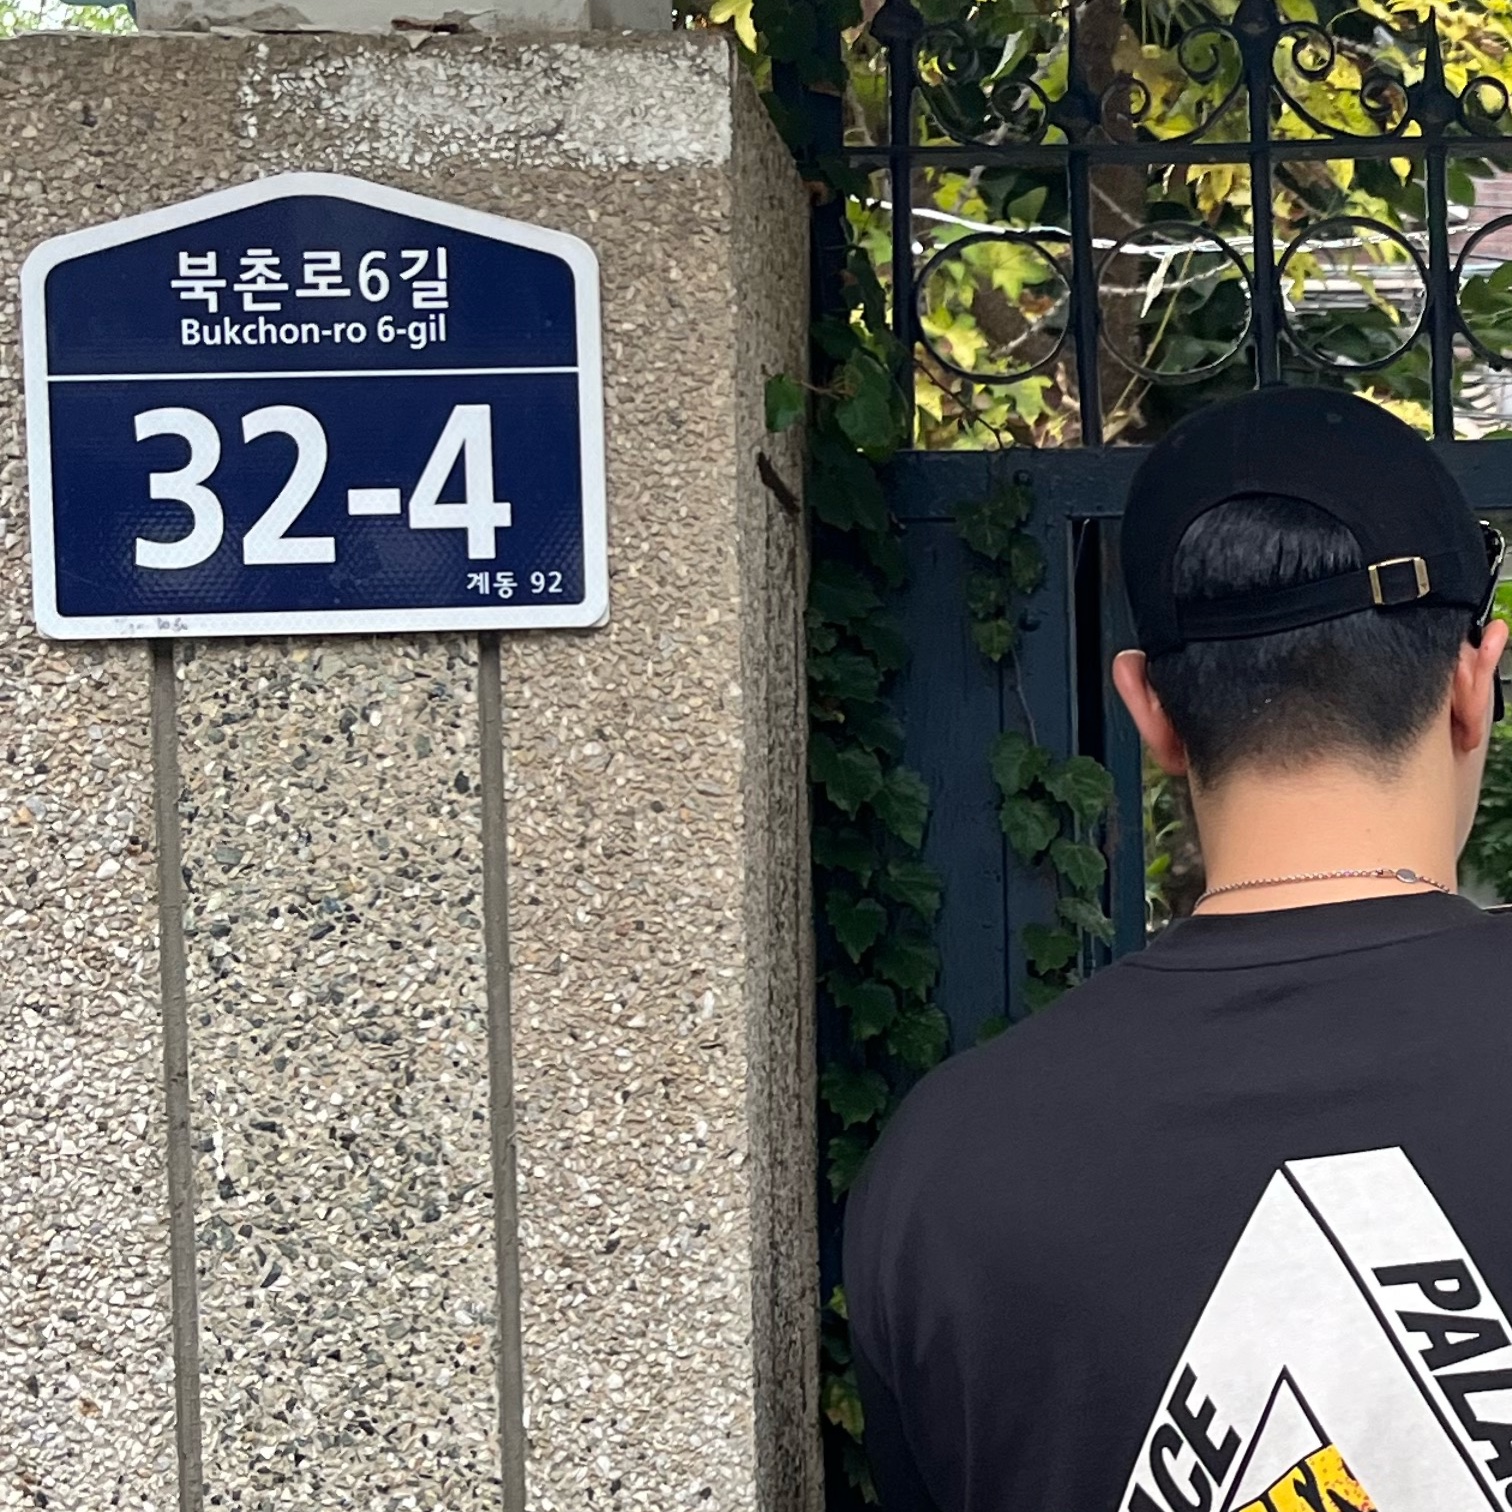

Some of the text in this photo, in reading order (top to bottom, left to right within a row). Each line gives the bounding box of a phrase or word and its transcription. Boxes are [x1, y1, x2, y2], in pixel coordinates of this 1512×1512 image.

[170, 246, 449, 313] 북촌로6길
[181, 313, 446, 350] Bukchon-ro 6-gil
[134, 403, 512, 571] 32-4
[466, 570, 563, 599] 계동 92
